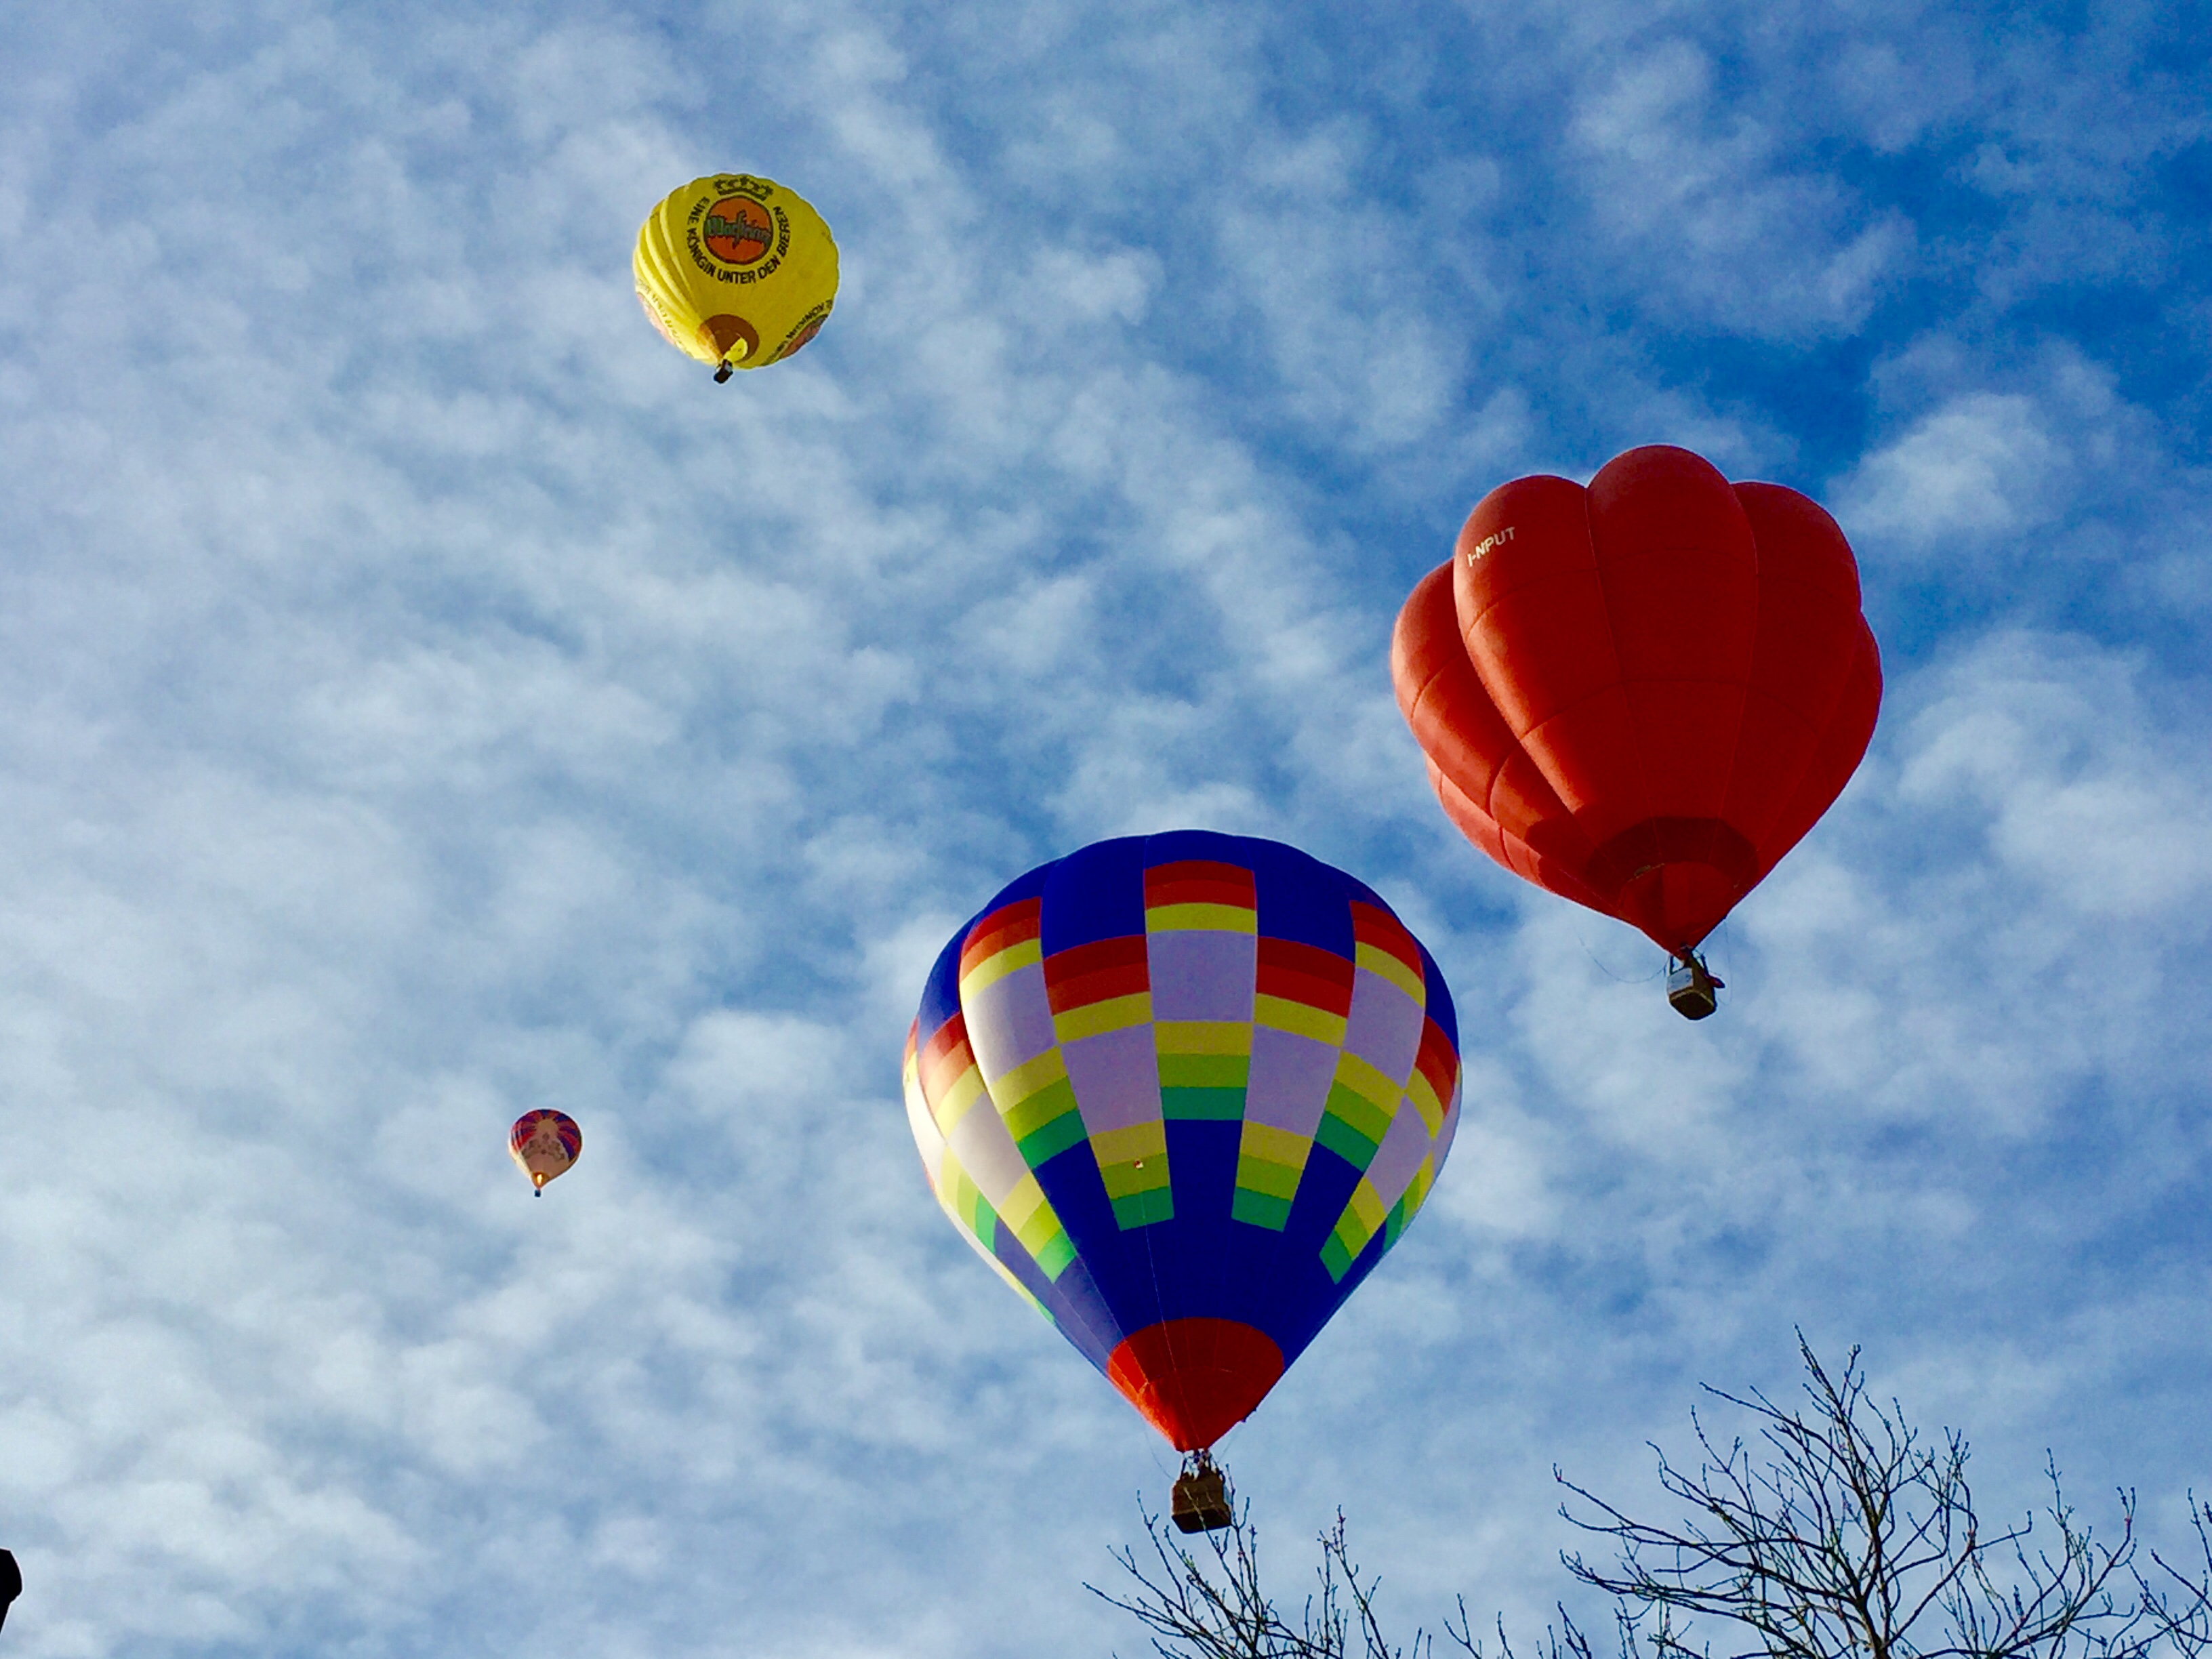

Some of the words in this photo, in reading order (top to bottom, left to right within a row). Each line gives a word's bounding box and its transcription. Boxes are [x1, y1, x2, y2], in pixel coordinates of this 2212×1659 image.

[687, 196, 710, 225] EINE
[717, 269, 756, 284] UNTER
[757, 255, 781, 279] DEN
[773, 205, 791, 258] BIEREN
[1467, 527, 1515, 567] I-NPUT
